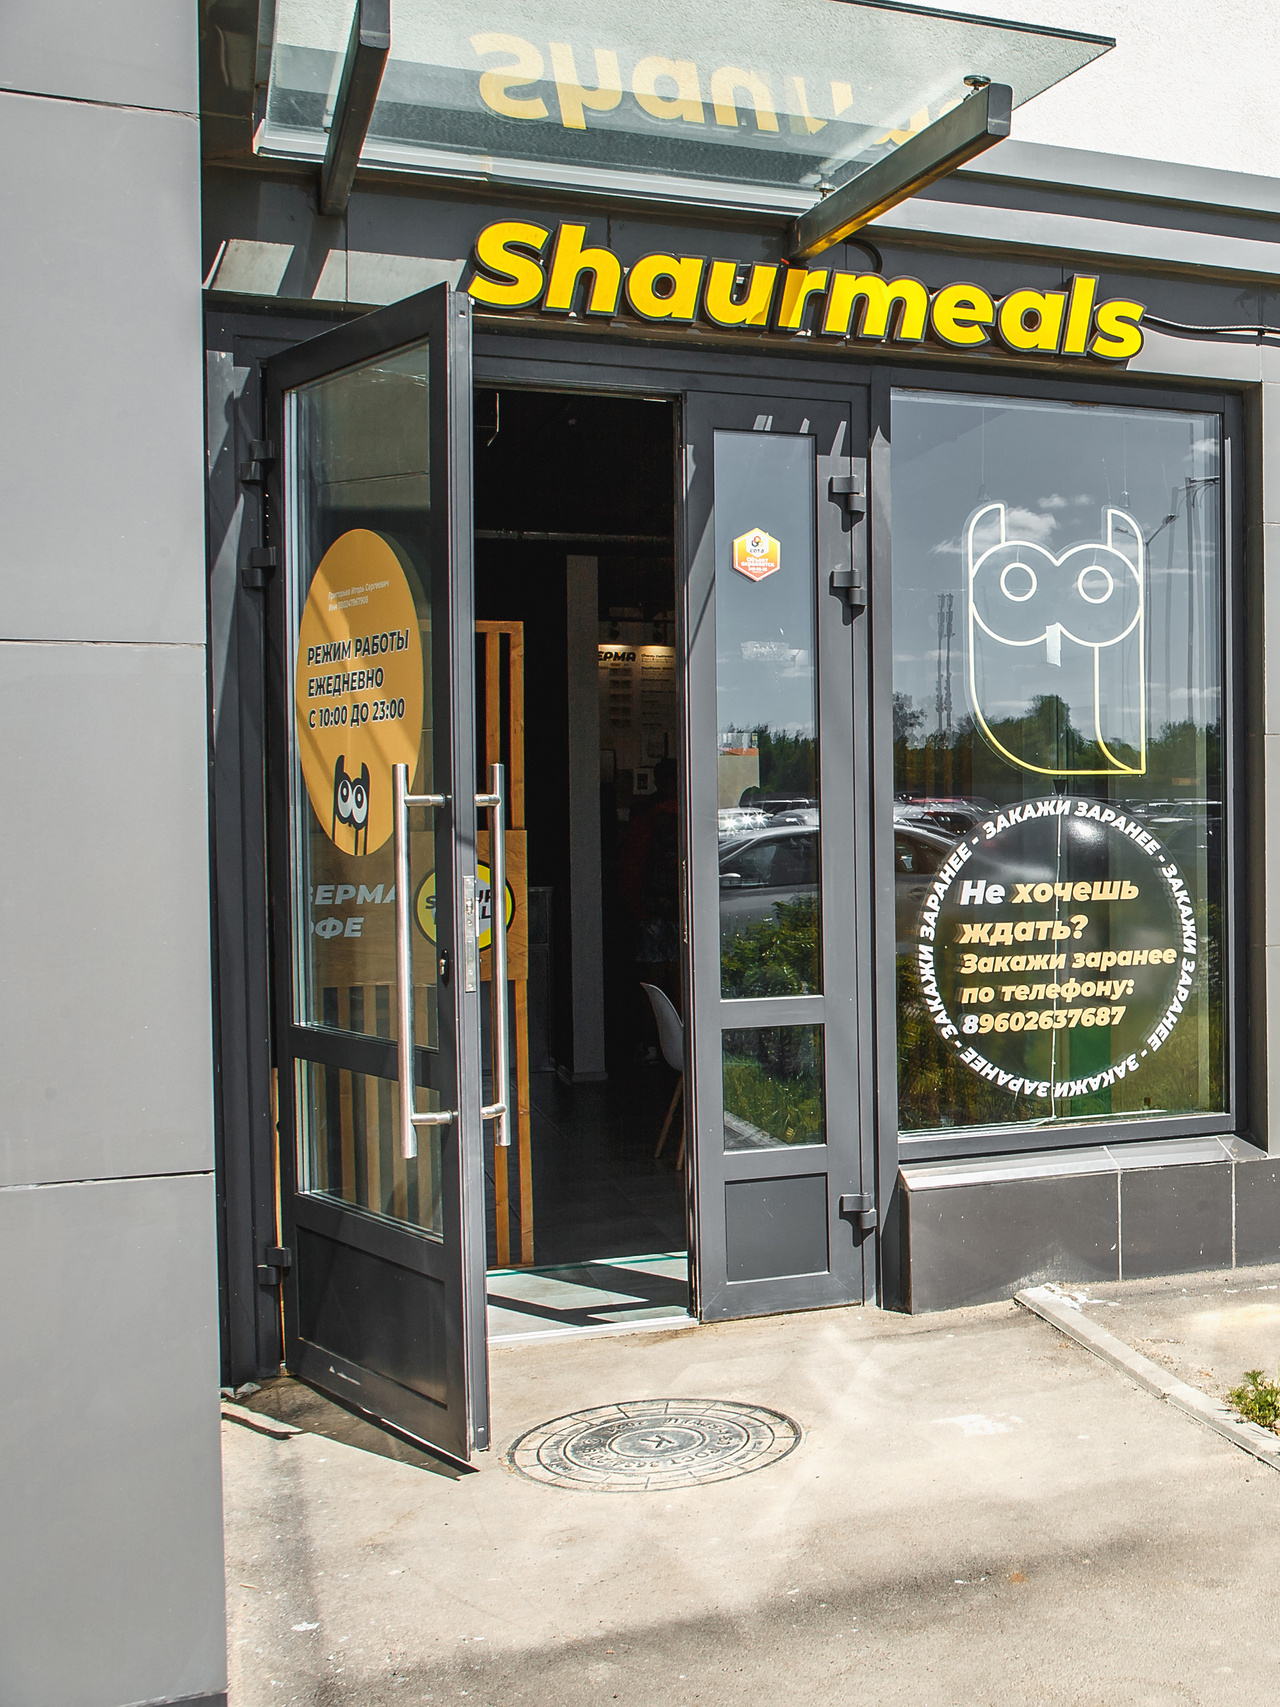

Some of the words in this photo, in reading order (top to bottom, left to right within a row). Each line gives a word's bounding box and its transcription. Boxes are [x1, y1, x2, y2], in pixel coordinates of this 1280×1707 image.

[468, 220, 1146, 360] Shaurmeals
[307, 639, 352, 667] РЕЖИМ
[354, 628, 410, 659] РАБОТЫ
[308, 666, 384, 698] ЕЖЕДНЕВНО
[309, 708, 316, 729] С
[319, 704, 348, 728] 10:00
[350, 702, 369, 728] ДО
[372, 697, 405, 722] 23:00
[982, 799, 1072, 840] ЗАКАЖИ
[1074, 800, 1162, 856] ЗАРАНЕЕ
[919, 842, 973, 941] ЗАРАНЕЕ
[959, 879, 1006, 906] Не
[1011, 880, 1140, 904] хочешь
[1161, 863, 1197, 955] ЗАКАЖИ
[309, 917, 364, 939] ФЕ
[958, 914, 1089, 947] ждать?
[960, 952, 1066, 974] Закажи
[1072, 947, 1178, 971] заранее
[918, 944, 958, 1040] ЗАКАЖИ
[961, 986, 995, 1005] по
[1001, 977, 1135, 1003] телефону:
[1146, 957, 1197, 1052] ЗАРАНЕЕ
[961, 1006, 1127, 1035] 89602637687
[959, 1047, 1050, 1098] ЗАРАНЕЕ
[1054, 1052, 1140, 1098] ЗАКАЖИ
